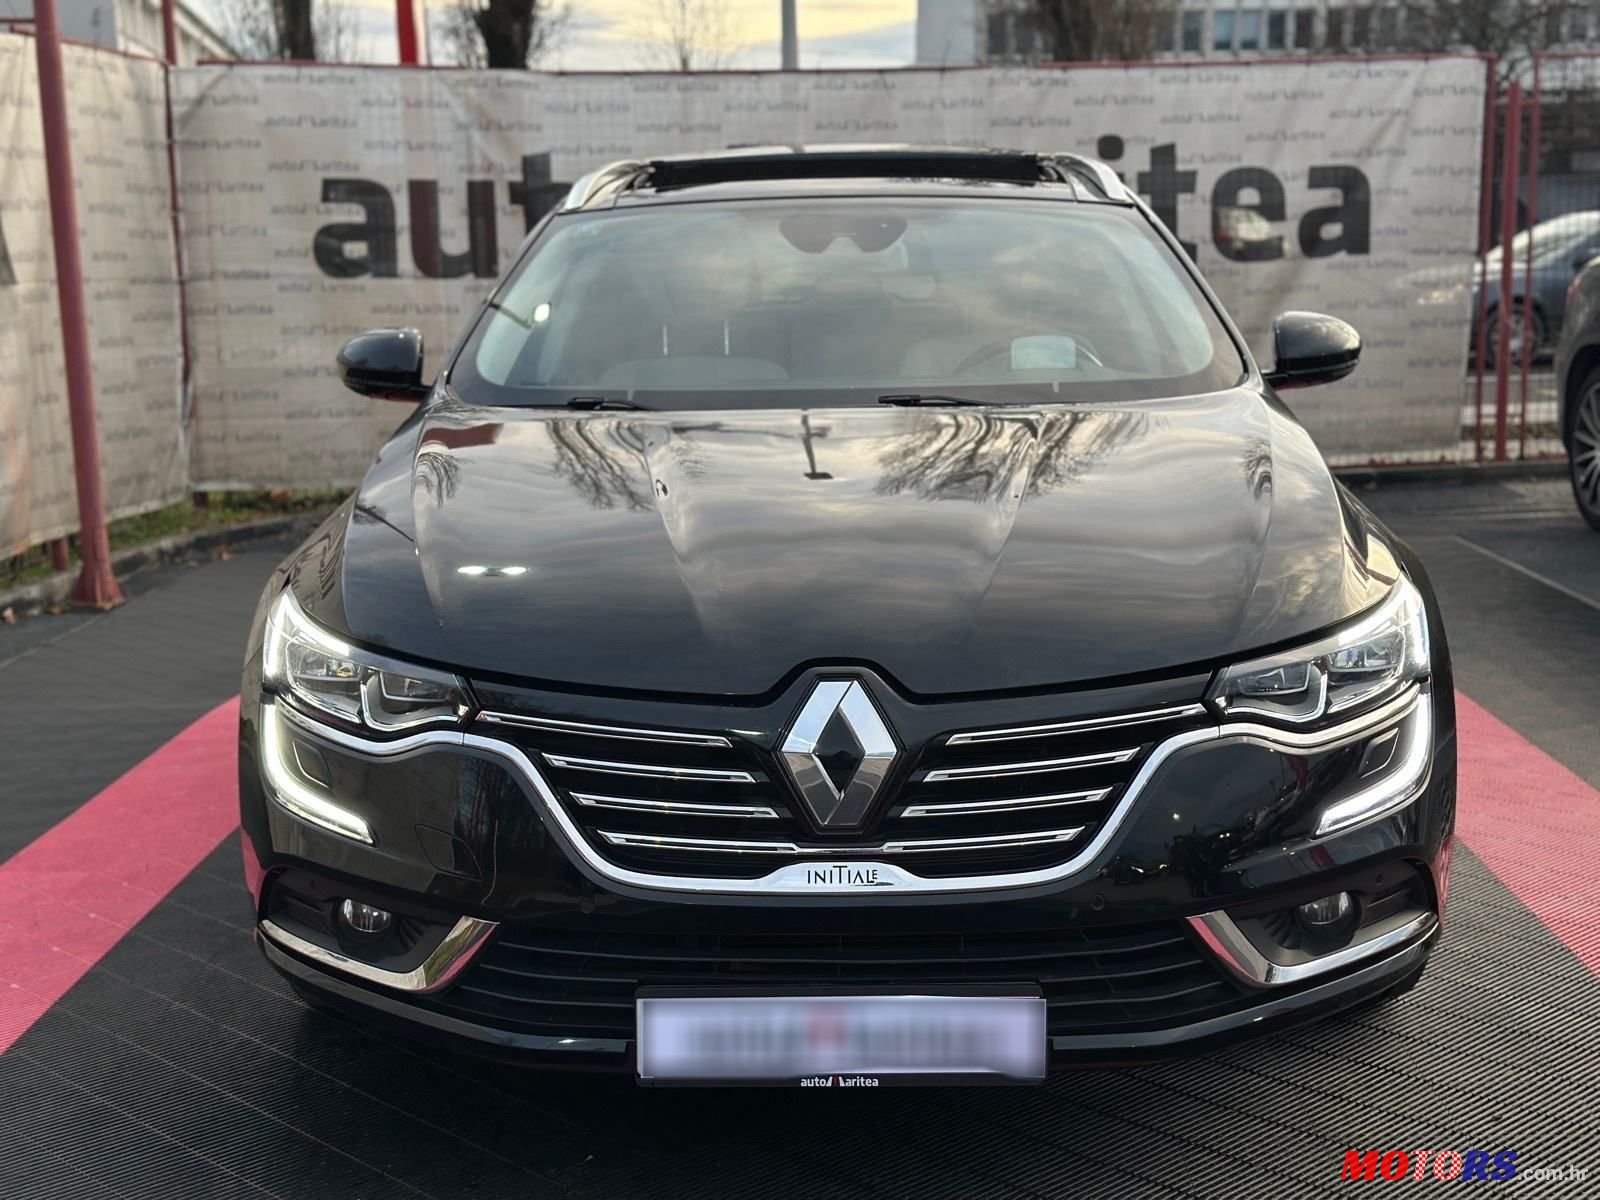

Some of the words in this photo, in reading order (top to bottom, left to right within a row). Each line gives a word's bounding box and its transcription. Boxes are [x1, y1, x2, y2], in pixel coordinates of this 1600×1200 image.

[313, 151, 575, 279] aut
[1096, 134, 1371, 262] tea
[807, 865, 878, 885] INITIALE
